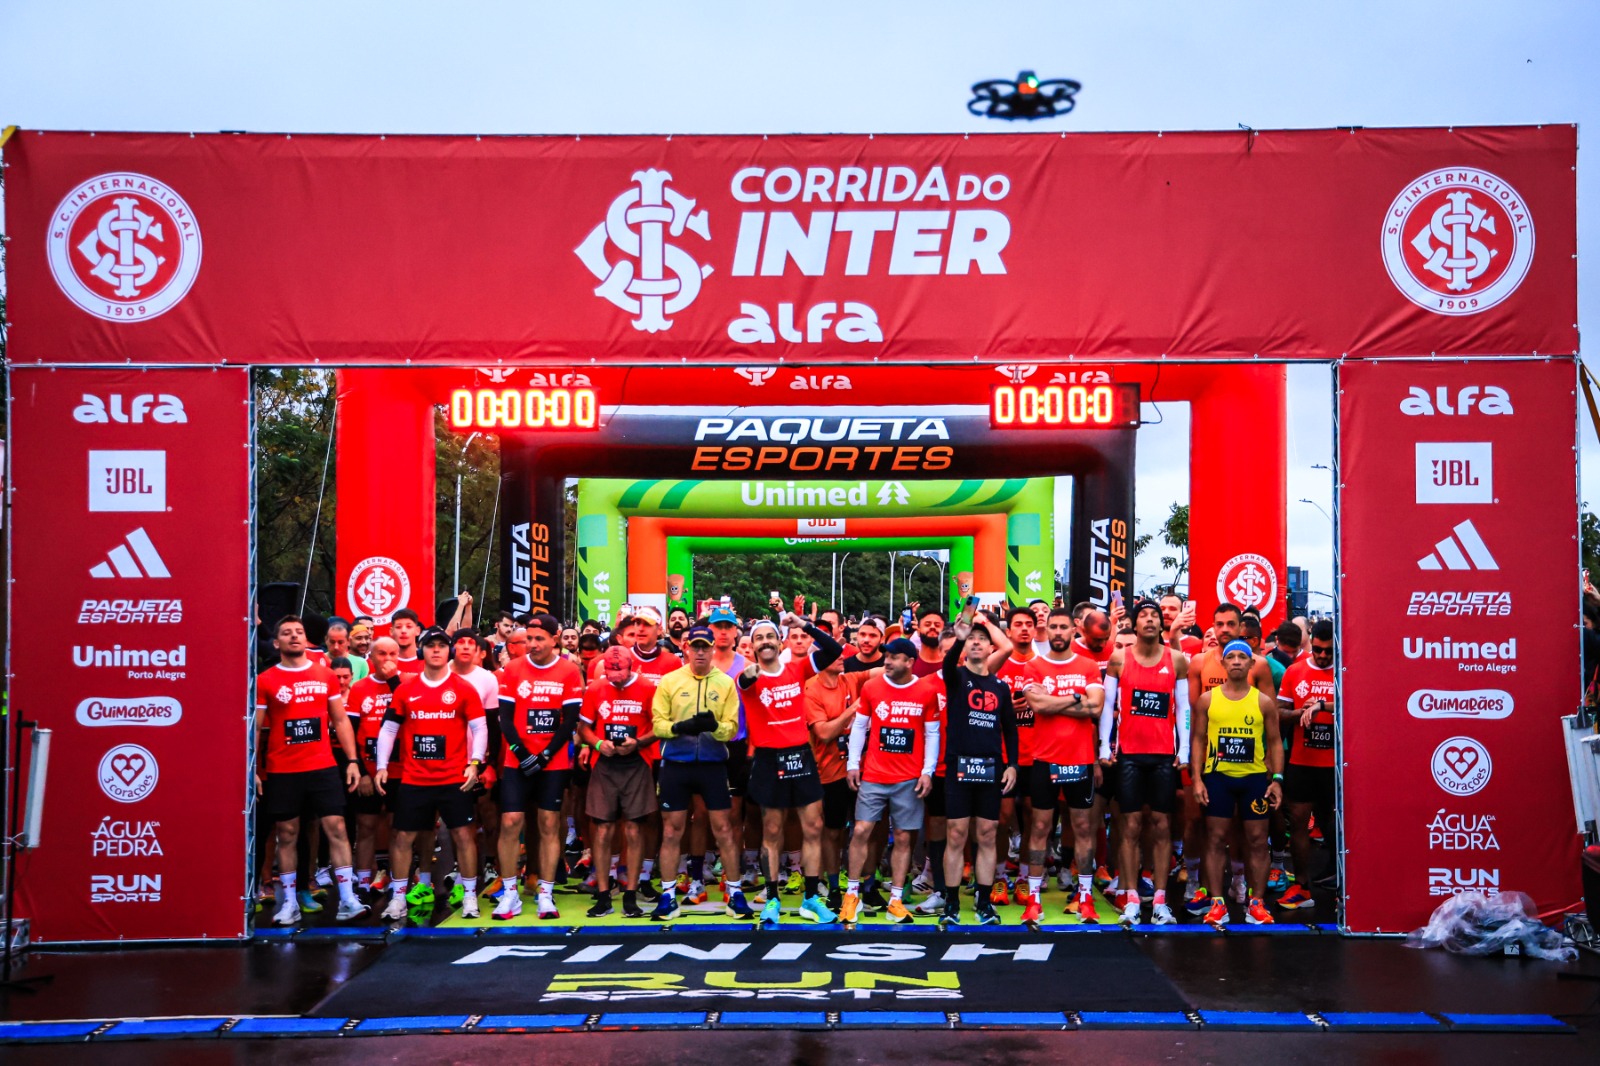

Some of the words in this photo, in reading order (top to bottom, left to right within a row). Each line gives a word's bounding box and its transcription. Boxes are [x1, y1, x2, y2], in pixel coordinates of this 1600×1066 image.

[731, 166, 950, 202] CORRIDA
[956, 174, 1010, 201] DO
[731, 209, 1011, 277] INTER
[106, 304, 147, 316] 1909
[1438, 298, 1479, 310] 1909
[727, 302, 884, 344] alfa
[789, 375, 853, 390] alfa
[1399, 386, 1514, 416] alfa
[73, 393, 188, 424] alfa
[451, 389, 596, 428] 00:00:00
[691, 446, 954, 471] ESPORTES
[1432, 460, 1479, 487] JBL
[105, 468, 153, 494] JBL
[740, 481, 867, 507] Unimed
[1406, 604, 1512, 616] ESPORTES
[77, 612, 183, 624] ESPORTES
[1403, 636, 1517, 659] Unimed
[73, 645, 186, 667] Unimed
[1458, 663, 1484, 672] Porto
[1486, 663, 1517, 674] Alegre
[128, 670, 153, 679] Porto
[155, 670, 186, 681] Alegre
[295, 685, 328, 695] INTER
[533, 685, 564, 695] INTER
[1311, 686, 1334, 695] INTE
[612, 704, 642, 714] INTER
[1140, 699, 1161, 710] 1972
[418, 710, 456, 719] Banrisul
[891, 706, 923, 716] INTER
[968, 711, 997, 721] ASSESSORIA
[535, 717, 554, 726] 1427
[968, 718, 994, 728] ESPORTIVA
[294, 726, 314, 736] 1814
[1218, 727, 1253, 735] JUBATUS
[1311, 731, 1331, 741] 1260
[886, 735, 906, 745] 1828
[419, 744, 437, 752] 1155
[1225, 745, 1246, 754] 1674
[786, 760, 803, 770] 1124
[966, 765, 986, 774] 1696
[1058, 765, 1080, 774] 1882
[1437, 768, 1447, 777] 3
[104, 775, 114, 784] 3
[1426, 808, 1492, 832] ÁGUA
[91, 816, 156, 839] ÁGUA
[1429, 832, 1500, 850] PEDRA
[93, 839, 163, 857] PEDRA
[91, 874, 162, 892] RUN
[1428, 868, 1499, 886] RUN
[91, 892, 161, 903] SPORTS
[451, 943, 1054, 964] FINISH
[547, 971, 960, 991] RUN
[539, 988, 964, 1002] SPORTS
